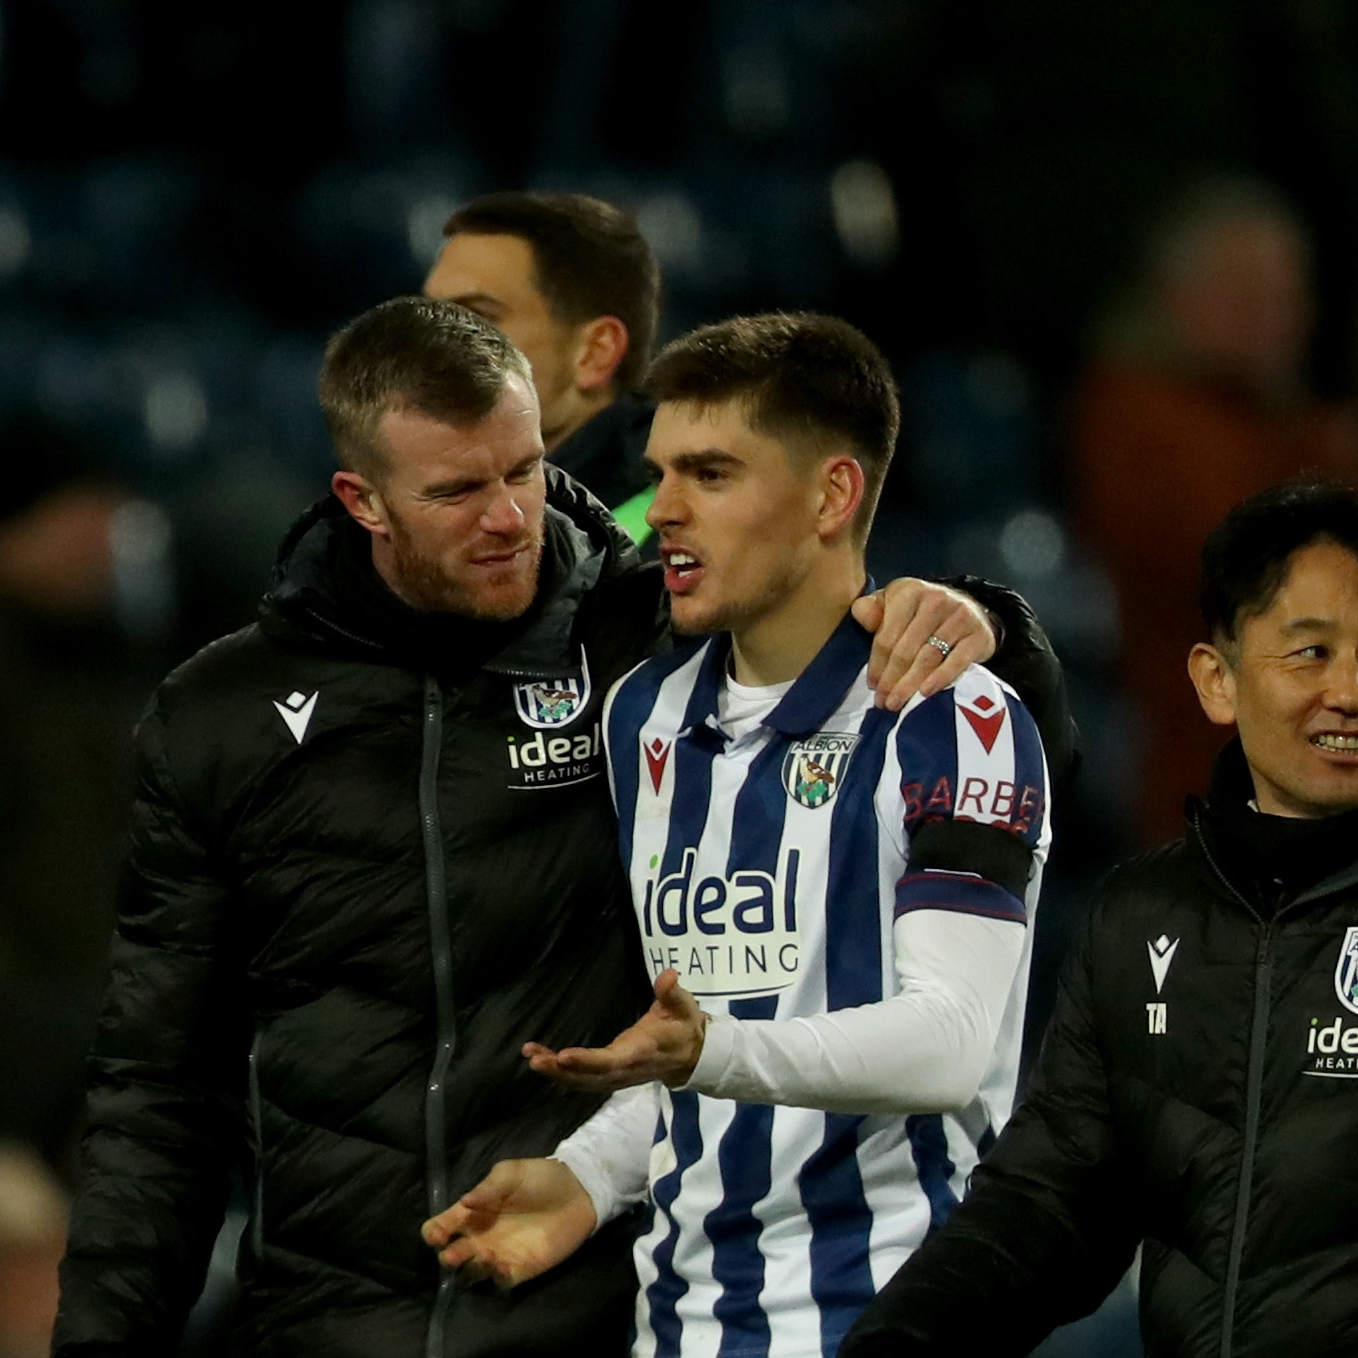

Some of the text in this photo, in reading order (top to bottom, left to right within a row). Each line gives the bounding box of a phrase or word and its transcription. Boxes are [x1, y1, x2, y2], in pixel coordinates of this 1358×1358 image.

[507, 722, 600, 769] ideal
[794, 740, 853, 751] ALBION
[524, 763, 590, 782] HEATING
[902, 776, 1045, 824] BARBE
[644, 848, 800, 938] ideal
[648, 943, 799, 976] HEATING
[1146, 1002, 1167, 1034] TA
